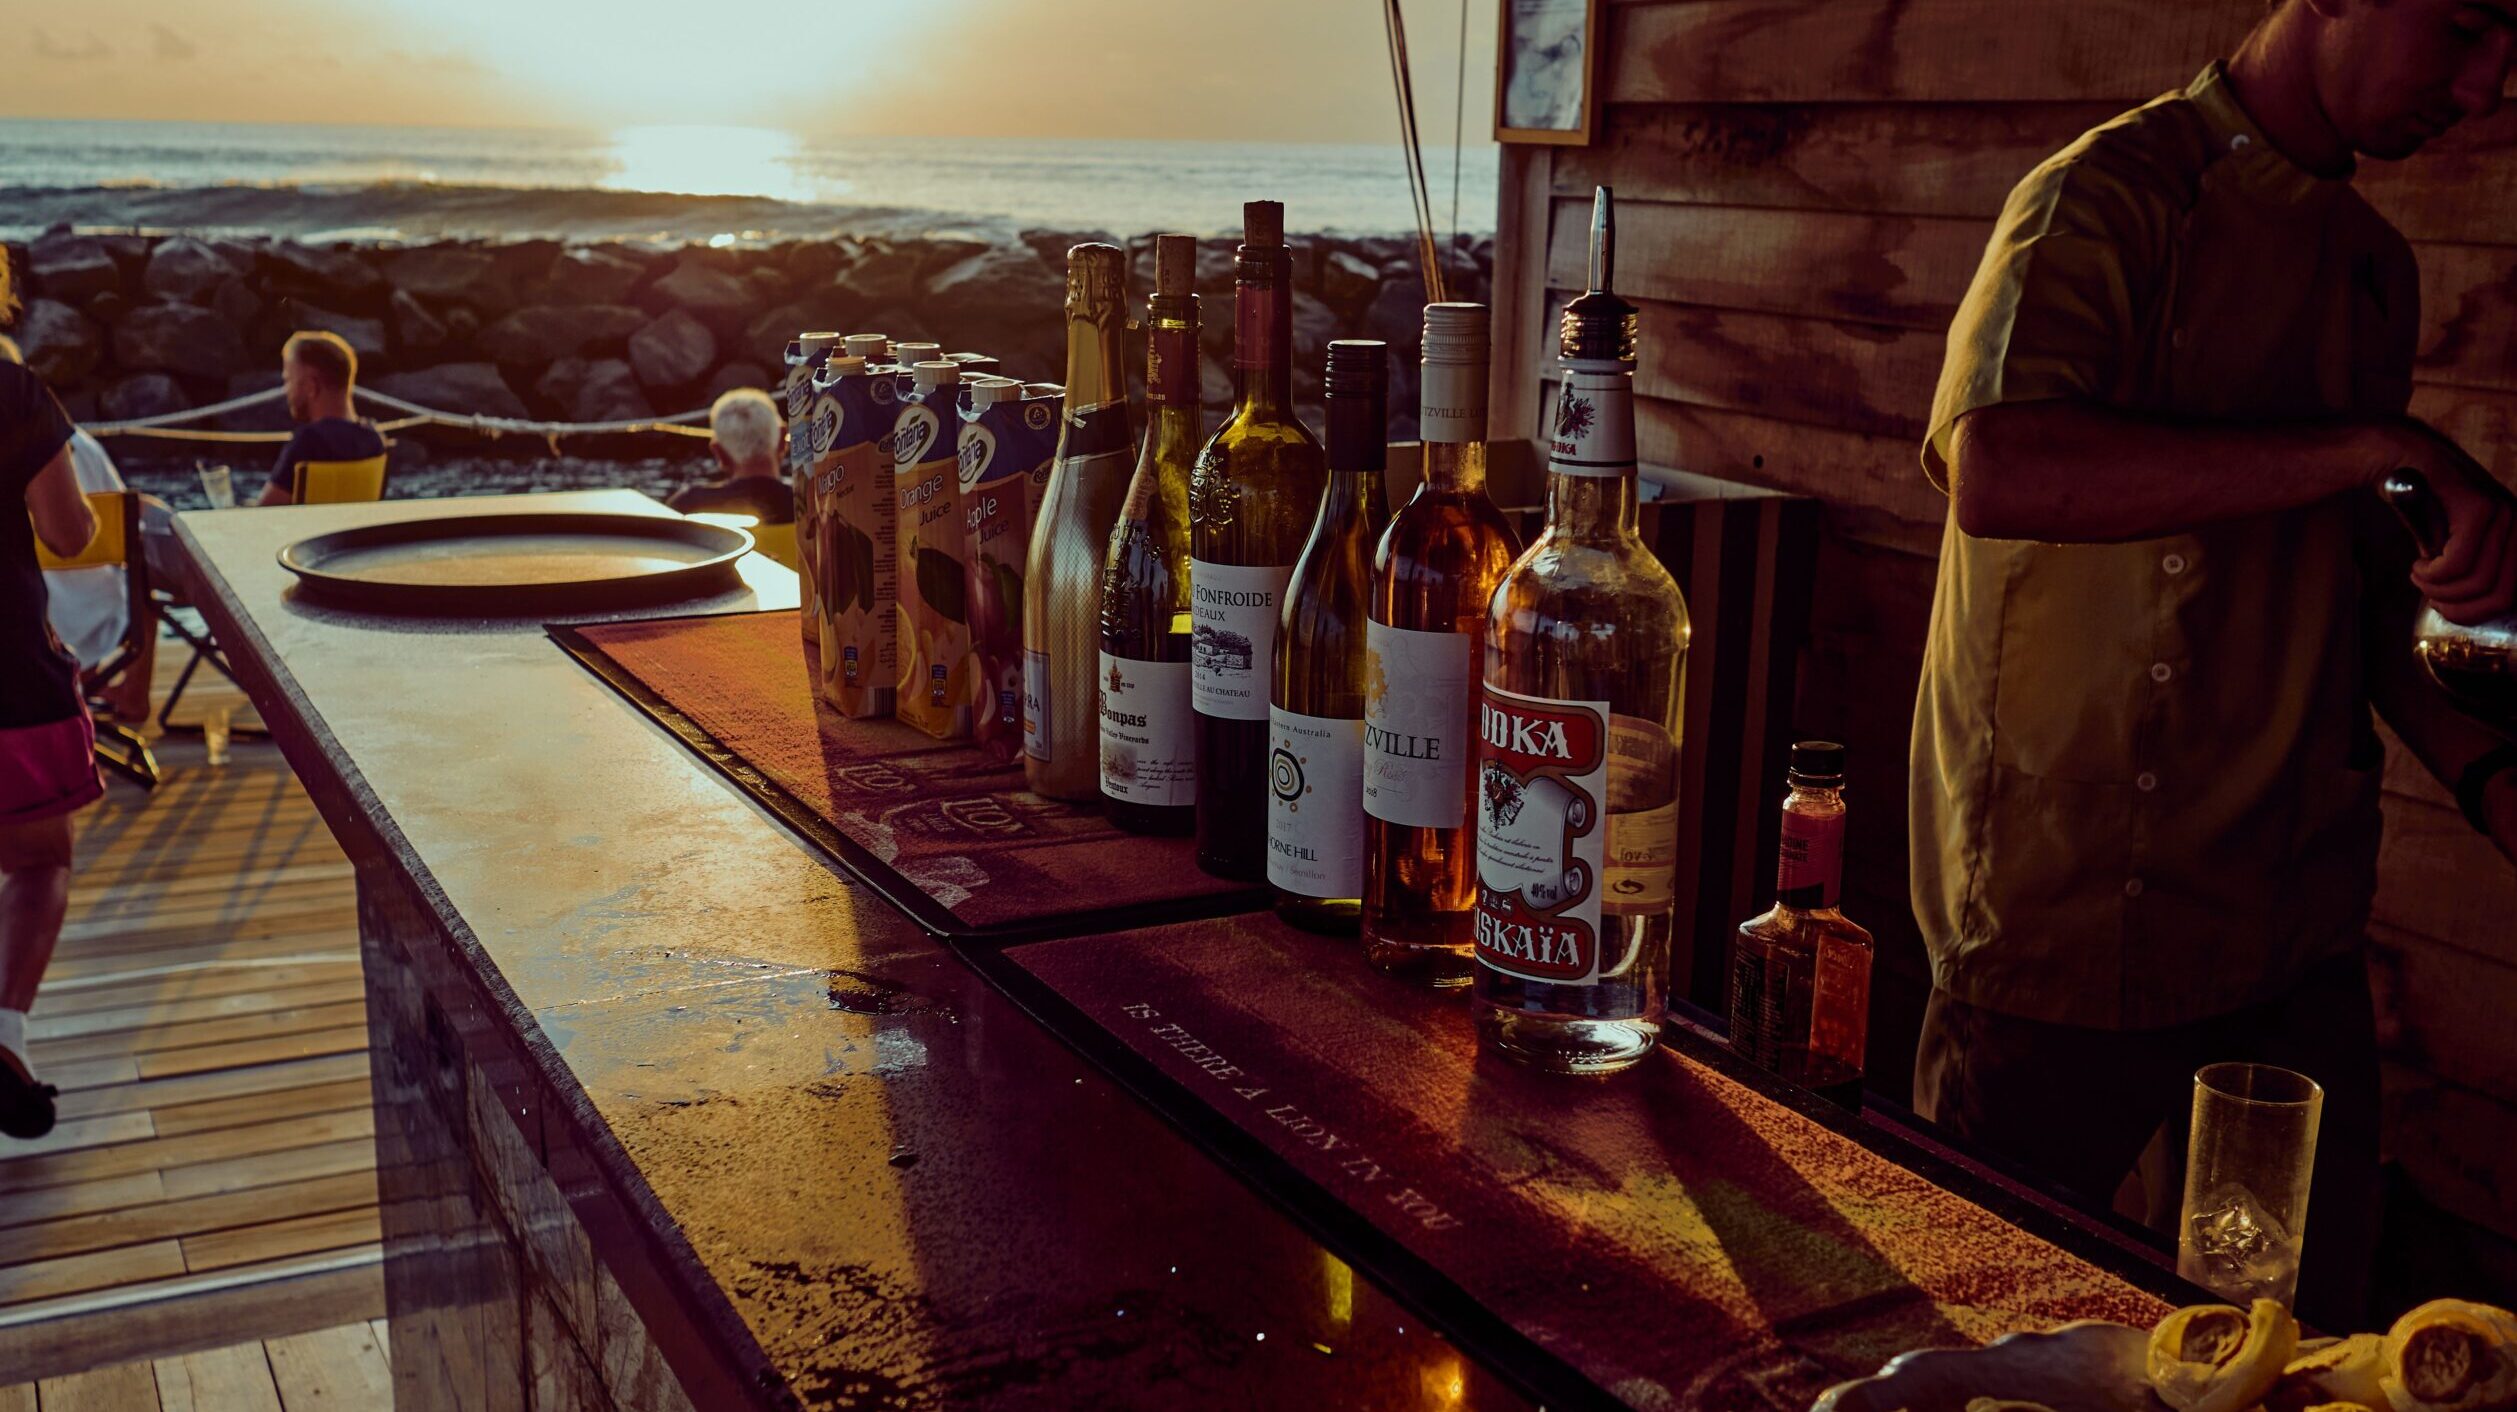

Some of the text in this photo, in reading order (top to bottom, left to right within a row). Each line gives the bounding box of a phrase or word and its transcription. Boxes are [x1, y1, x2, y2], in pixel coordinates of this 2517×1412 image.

[894, 421, 926, 455] ontana
[958, 439, 982, 473] ontana
[900, 474, 944, 510] Orange
[920, 501, 951, 526] Juice
[967, 497, 997, 529] Apple
[980, 518, 1009, 545] Juice
[1196, 584, 1273, 607] FONFROIDE
[1292, 725, 1332, 738] Australia
[1294, 845, 1318, 862] HILL
[1121, 1002, 1160, 1021] IS
[1149, 1022, 1245, 1081] THERE
[1232, 1084, 1271, 1101] A
[1265, 1103, 1357, 1151] LION
